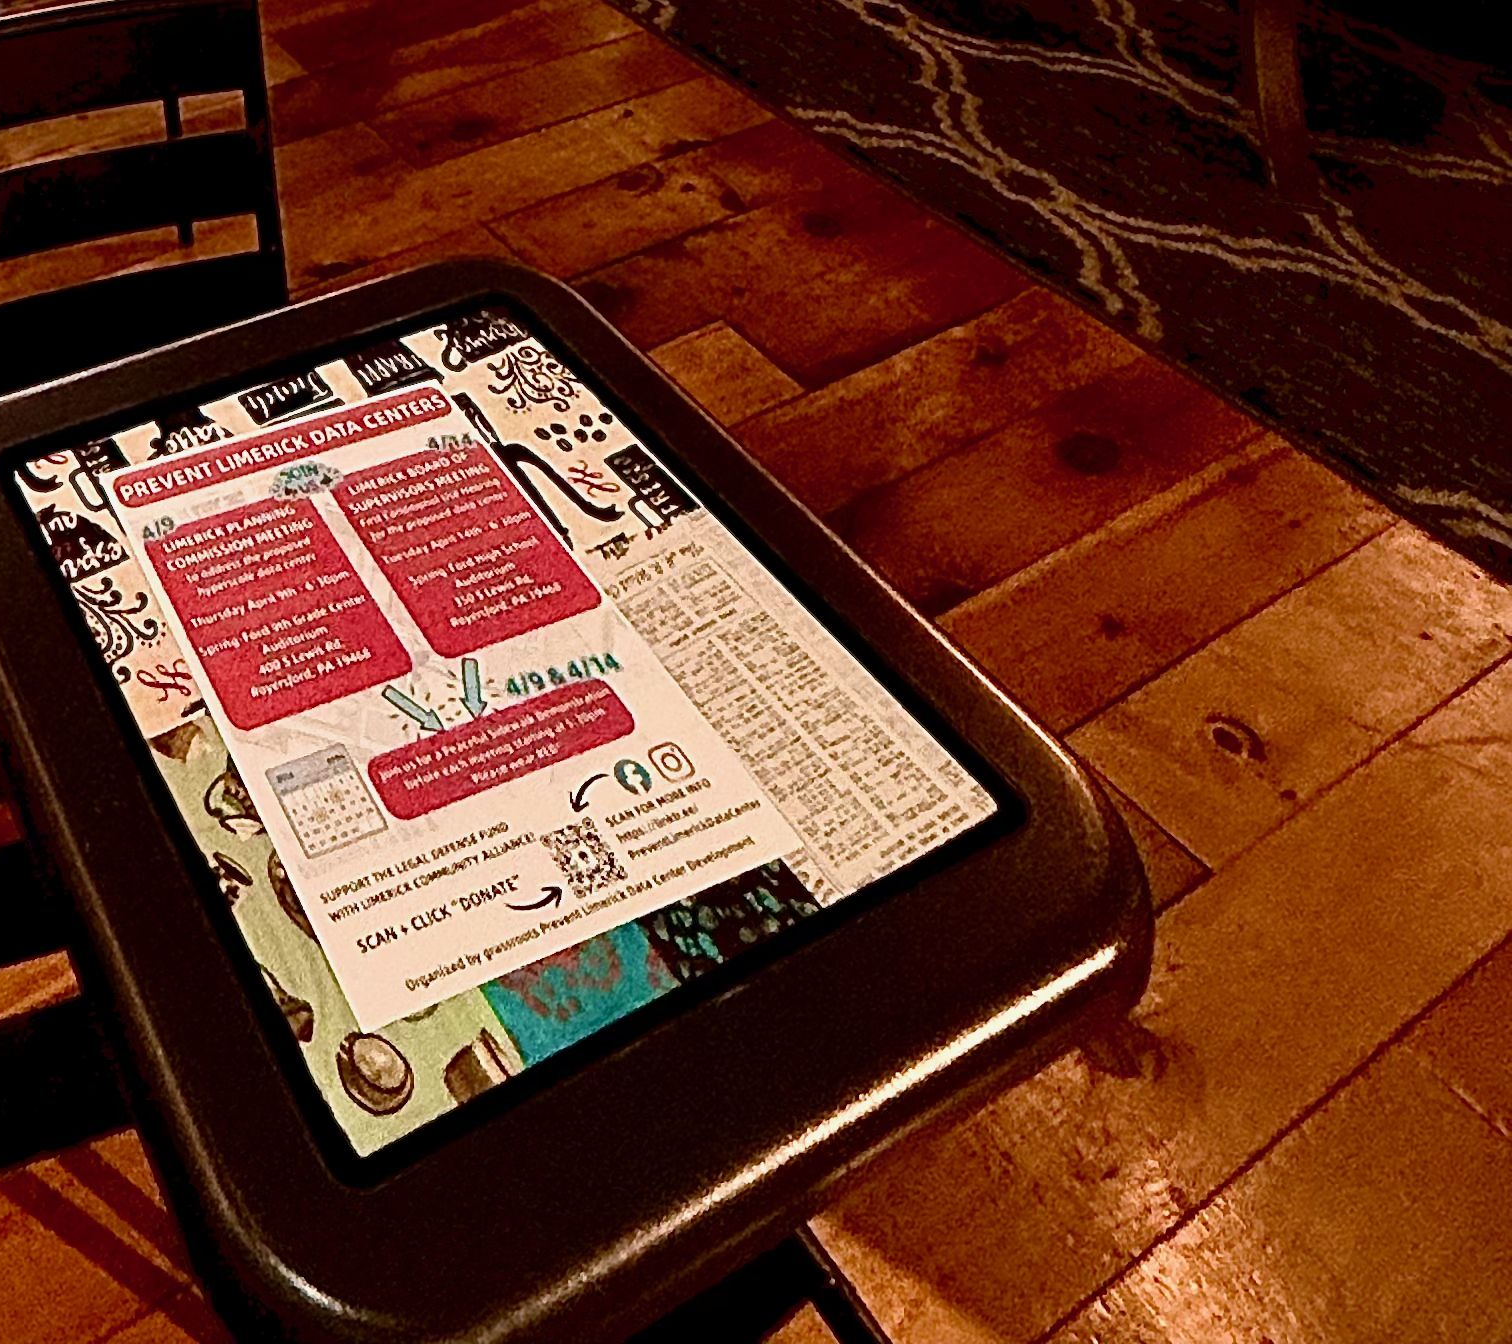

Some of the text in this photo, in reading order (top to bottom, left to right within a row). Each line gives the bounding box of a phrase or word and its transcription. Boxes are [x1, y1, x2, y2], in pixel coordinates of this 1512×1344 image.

[120, 394, 448, 500] PREVENT LIMERICK DATA CENTERS
[348, 472, 406, 495] LIMERICK
[348, 463, 489, 513] SUPERVISORS MEETING
[161, 505, 295, 553] LIMERICK PLANNING
[166, 518, 313, 570] COMMISSION MEETING
[455, 562, 515, 588] Auditorium
[190, 605, 245, 627] Thursday
[247, 593, 276, 611] April
[292, 607, 327, 625] Grade
[328, 595, 365, 612] Center
[262, 626, 328, 654] Auditorium
[316, 660, 335, 675] PA
[507, 672, 545, 695] 4/9
[568, 653, 620, 685] 4/14
[605, 778, 711, 827] SCAN FOR MORE INFO
[320, 822, 508, 904] SUPPORT THE LEGAL DEFENSE FUND
[328, 902, 359, 922] WITH
[360, 882, 412, 910] LIMERICK
[413, 855, 478, 888] COMMUNITY
[356, 927, 397, 953] SCAN
[410, 904, 451, 930] CLICK
[405, 836, 755, 991] Organized by grassroots Prevent Limerick Data Center Development
